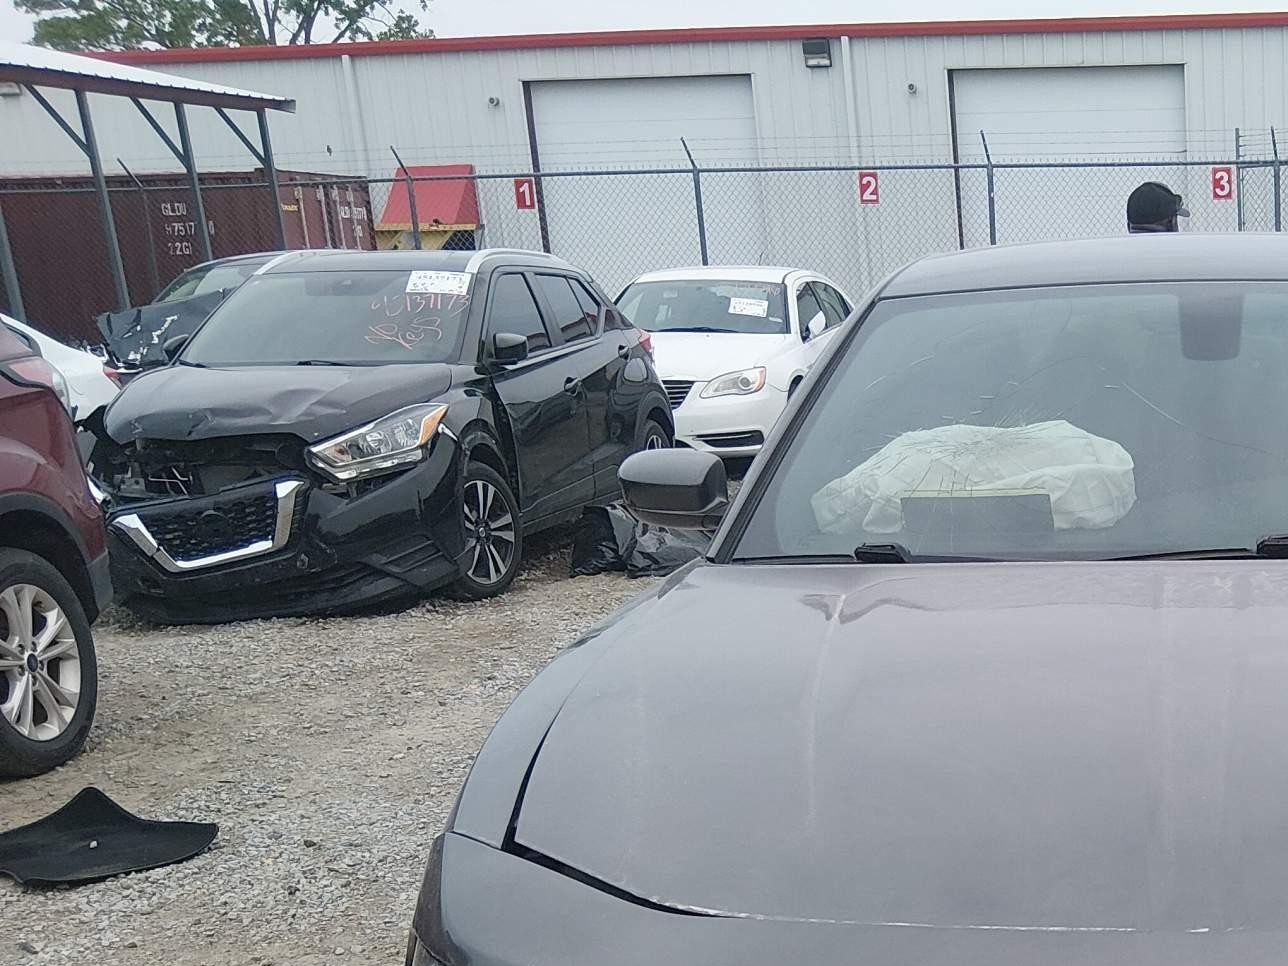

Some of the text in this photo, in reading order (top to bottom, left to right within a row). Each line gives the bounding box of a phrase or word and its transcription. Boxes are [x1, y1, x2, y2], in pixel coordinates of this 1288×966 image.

[520, 183, 531, 205] 1
[862, 176, 876, 200] 2
[1215, 171, 1230, 196] 3
